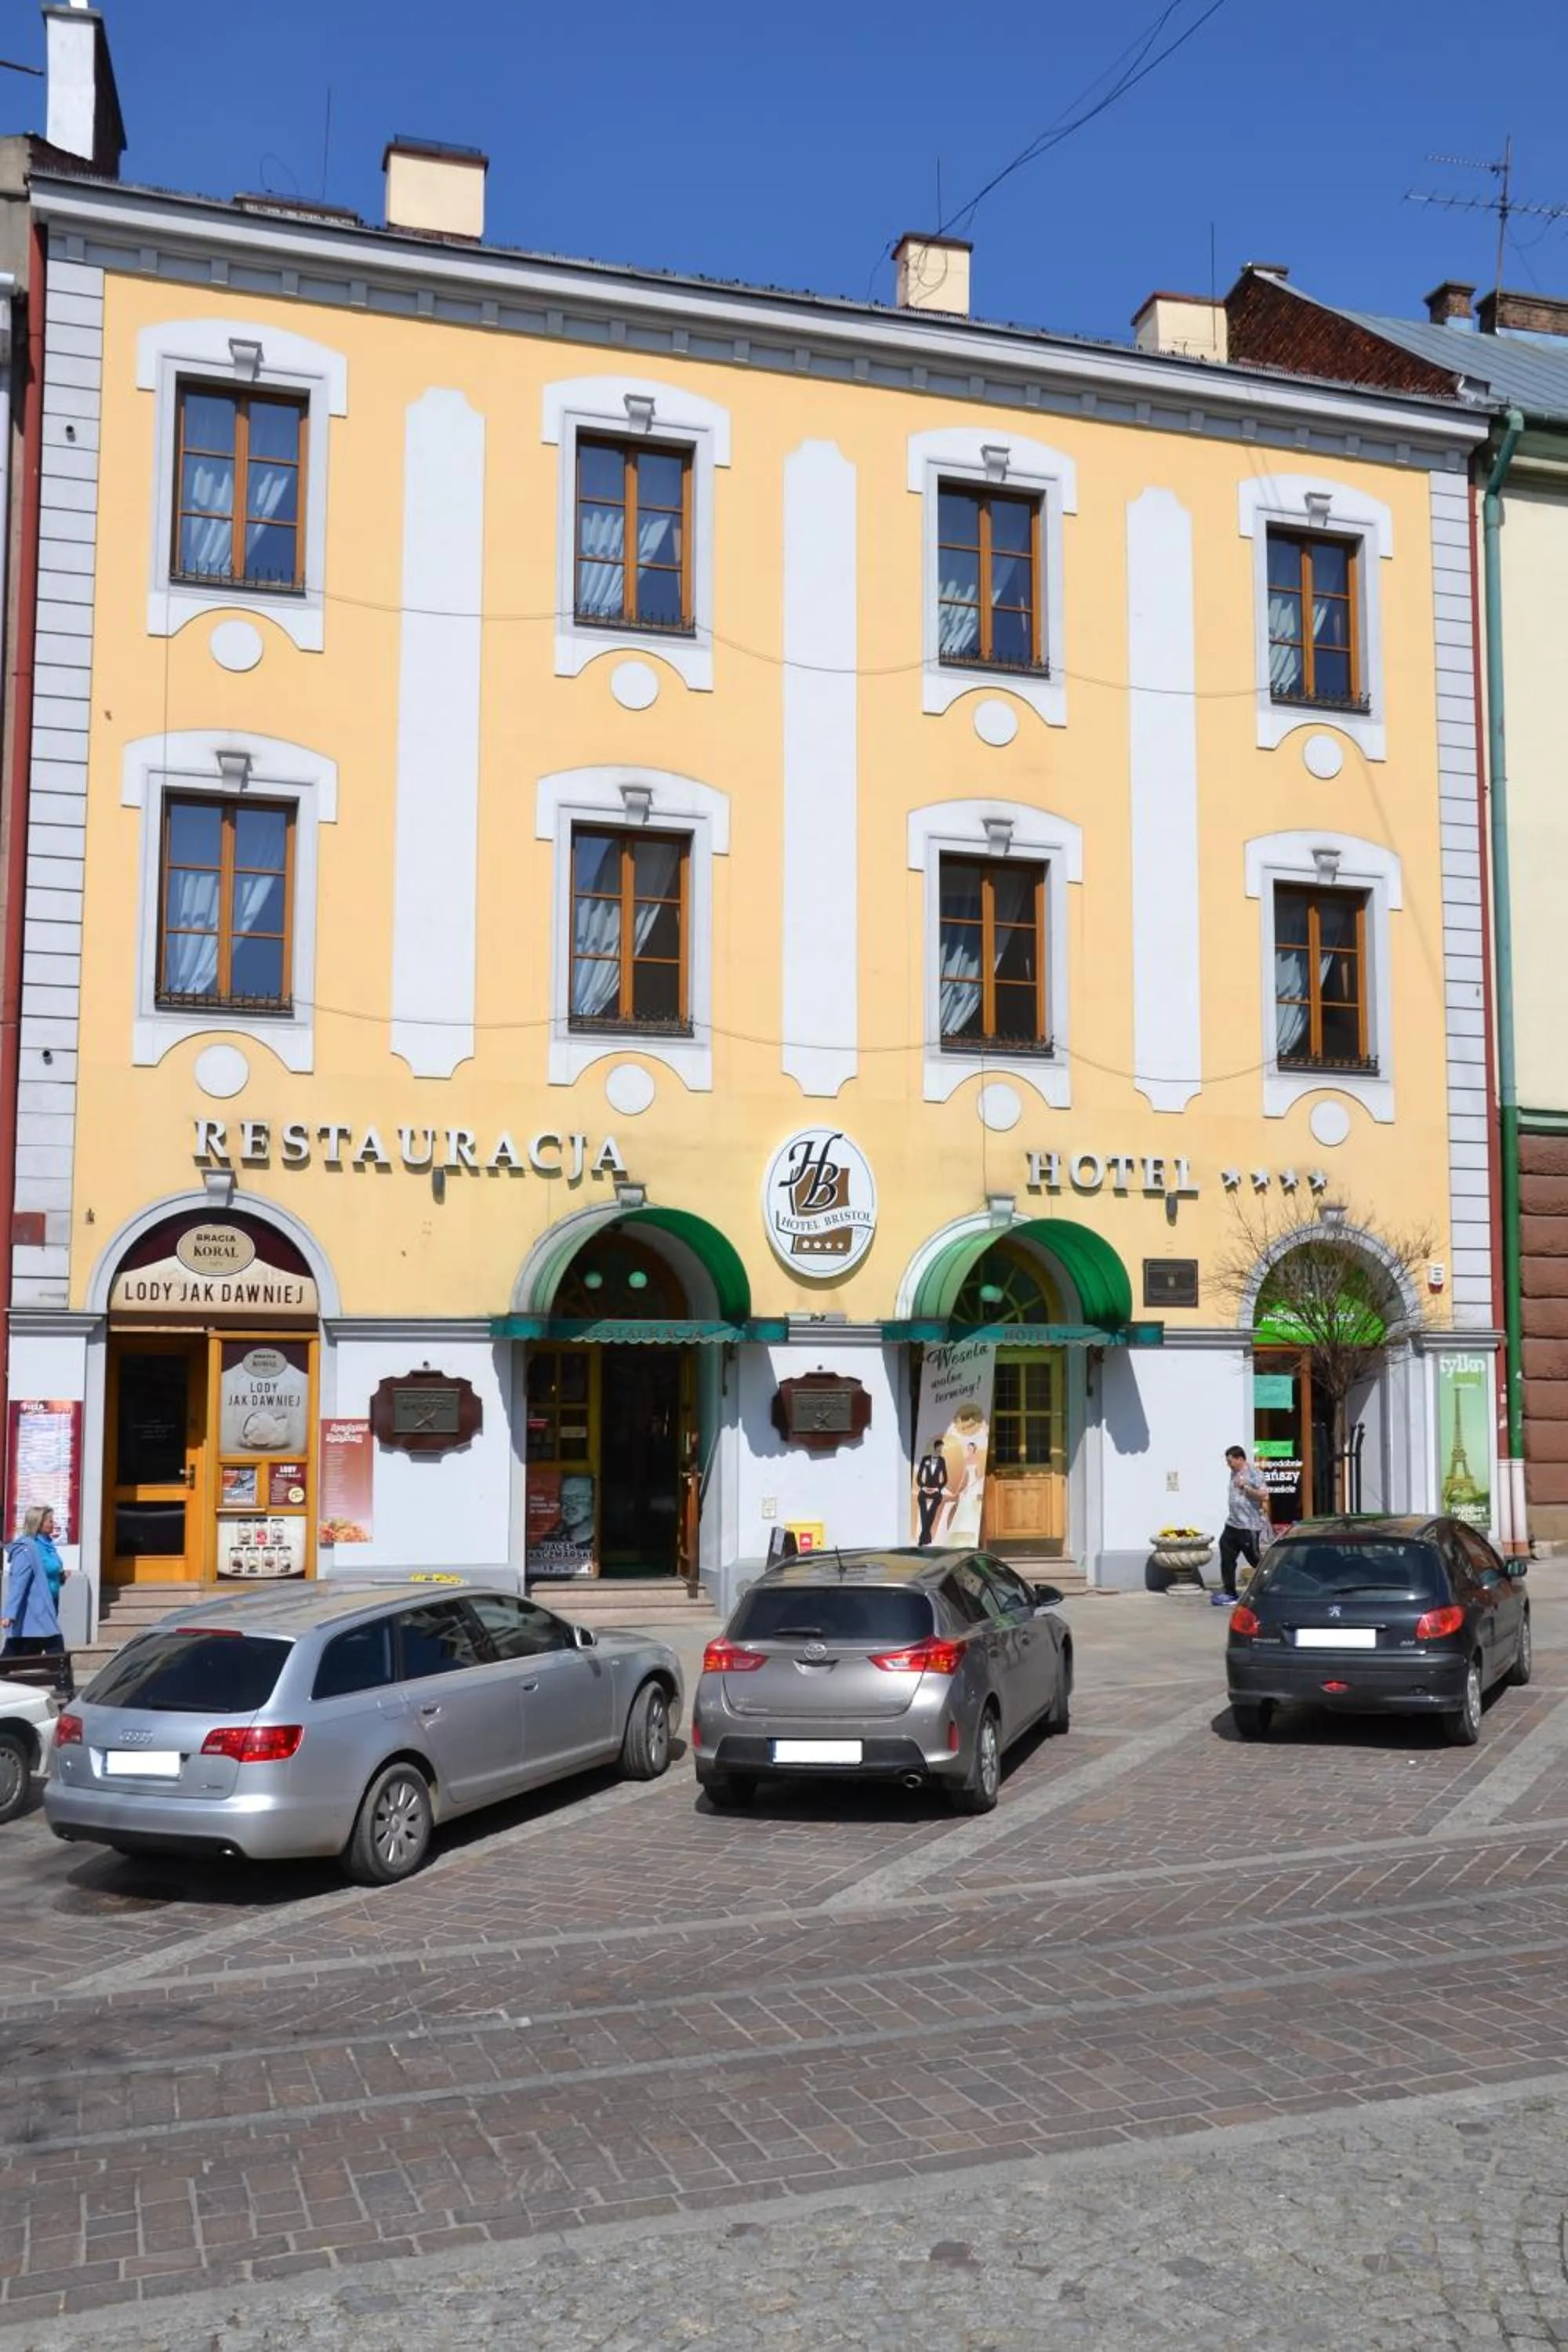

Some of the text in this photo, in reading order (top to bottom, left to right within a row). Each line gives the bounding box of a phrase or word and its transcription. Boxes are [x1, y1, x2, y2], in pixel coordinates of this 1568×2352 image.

[194, 1119, 628, 1184] RESTAURACJA
[1026, 1150, 1200, 1196] HOTEL
[781, 1210, 873, 1232] HOTEL BRISTOL
[196, 1232, 236, 1243] BRACIA
[193, 1245, 239, 1258] KORAL
[125, 1281, 304, 1305] LODY JAK DAWNIEJ
[1004, 1328, 1051, 1341] HOTEL
[926, 1341, 989, 1370] Wesela
[250, 1382, 278, 1393] LODY
[931, 1370, 962, 1389] wolne
[935, 1374, 982, 1404] terminy!
[228, 1395, 301, 1407] JAK DAWNIEJ
